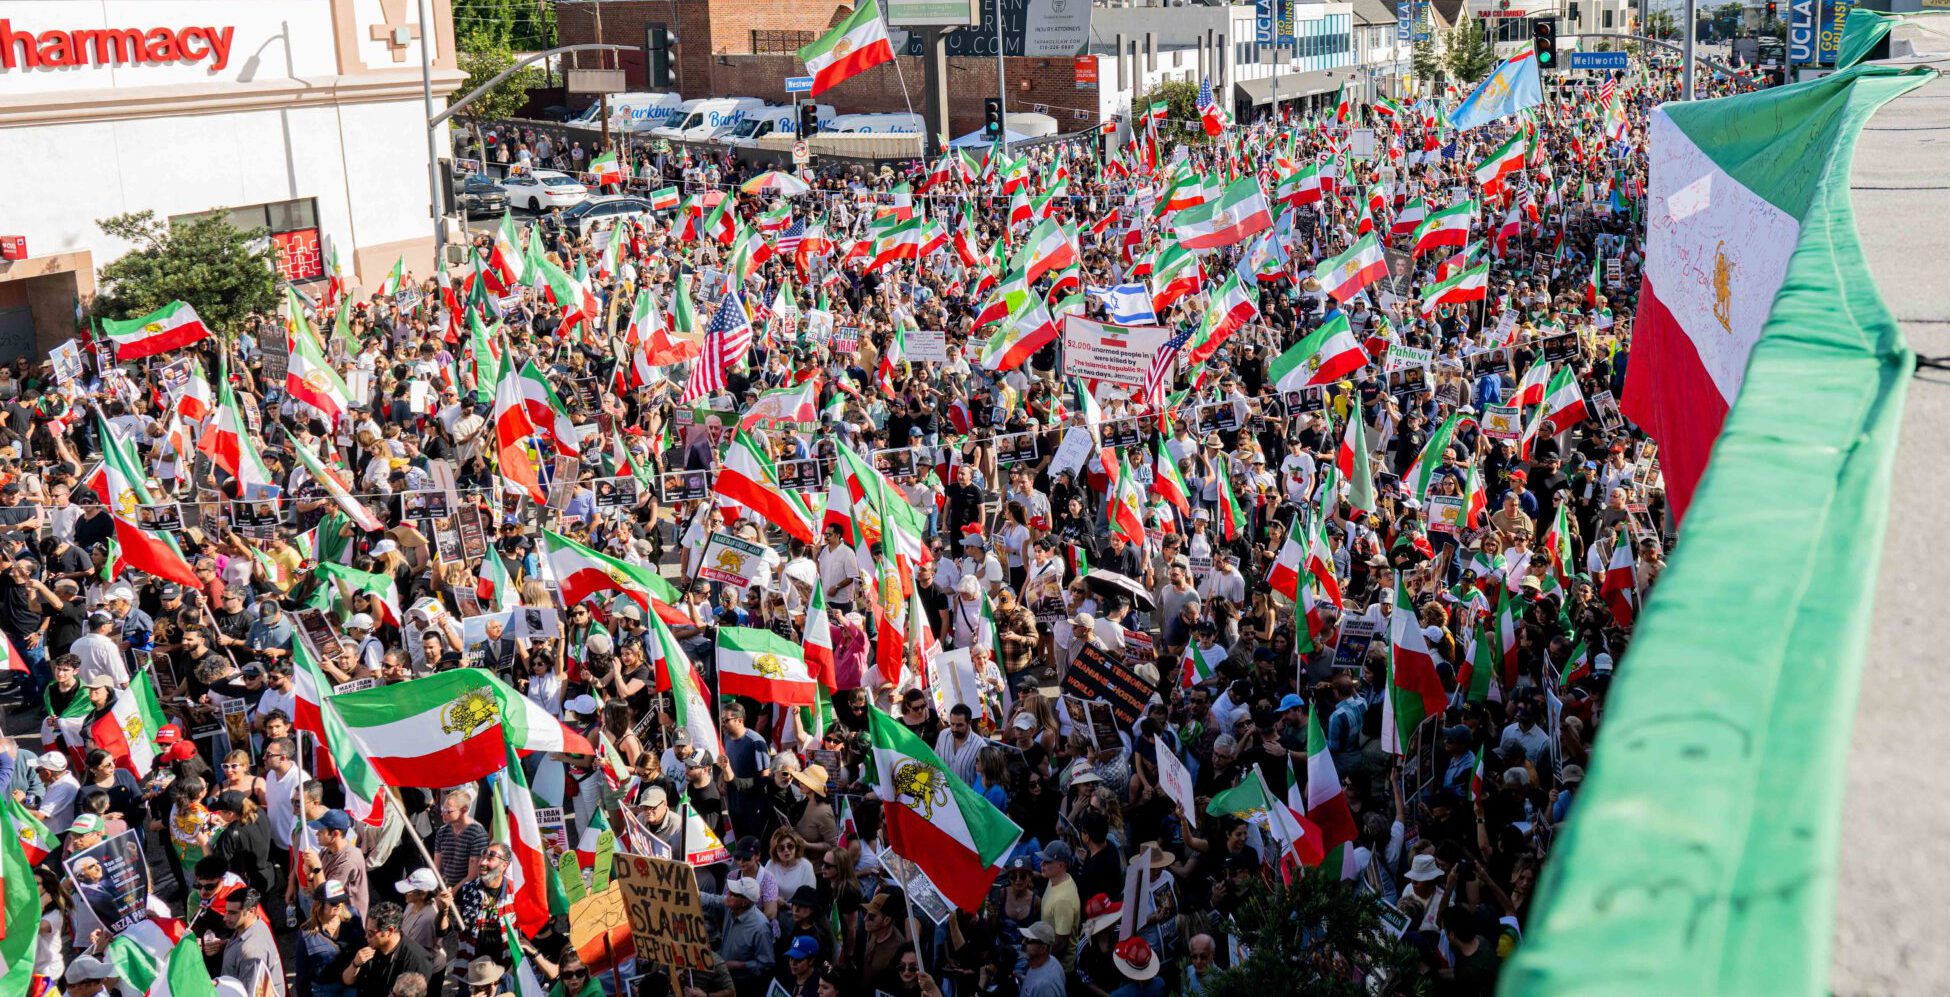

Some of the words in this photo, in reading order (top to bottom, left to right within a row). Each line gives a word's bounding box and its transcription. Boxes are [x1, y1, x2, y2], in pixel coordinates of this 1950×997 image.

[1258, 0, 1271, 42] UCLA
[1278, 20, 1285, 36] GO
[1400, 4, 1410, 40] UCLA
[1833, 2, 1846, 50] BRUINS!
[1791, 1, 1812, 59] UCLA
[0, 18, 234, 70] harmacy
[1821, 31, 1833, 51] GO
[1573, 56, 1625, 66] Wellworth
[840, 327, 858, 340] FREE
[837, 340, 857, 352] IRAN
[1389, 345, 1428, 361] Pahlavi
[1094, 354, 1110, 362] were
[1110, 356, 1128, 365] killed
[1120, 350, 1142, 359] people
[1394, 358, 1401, 366] is
[1072, 366, 1084, 374] jst
[1114, 372, 1139, 383] January
[1086, 361, 1108, 370] Islamic
[1108, 364, 1136, 374] Republic
[747, 544, 760, 554] AGAIN
[704, 569, 716, 579] Long
[725, 572, 744, 584] Pahlavi
[463, 650, 485, 660] KING
[338, 684, 356, 692] MAKE
[356, 679, 372, 688] IRAN
[1067, 675, 1095, 697] WORLD
[1112, 665, 1153, 696] TERRORIST
[543, 809, 560, 817] IRAN
[544, 815, 561, 823] AGAIN
[696, 852, 714, 863] Long
[628, 883, 690, 907] WITH
[111, 915, 133, 932] REZA
